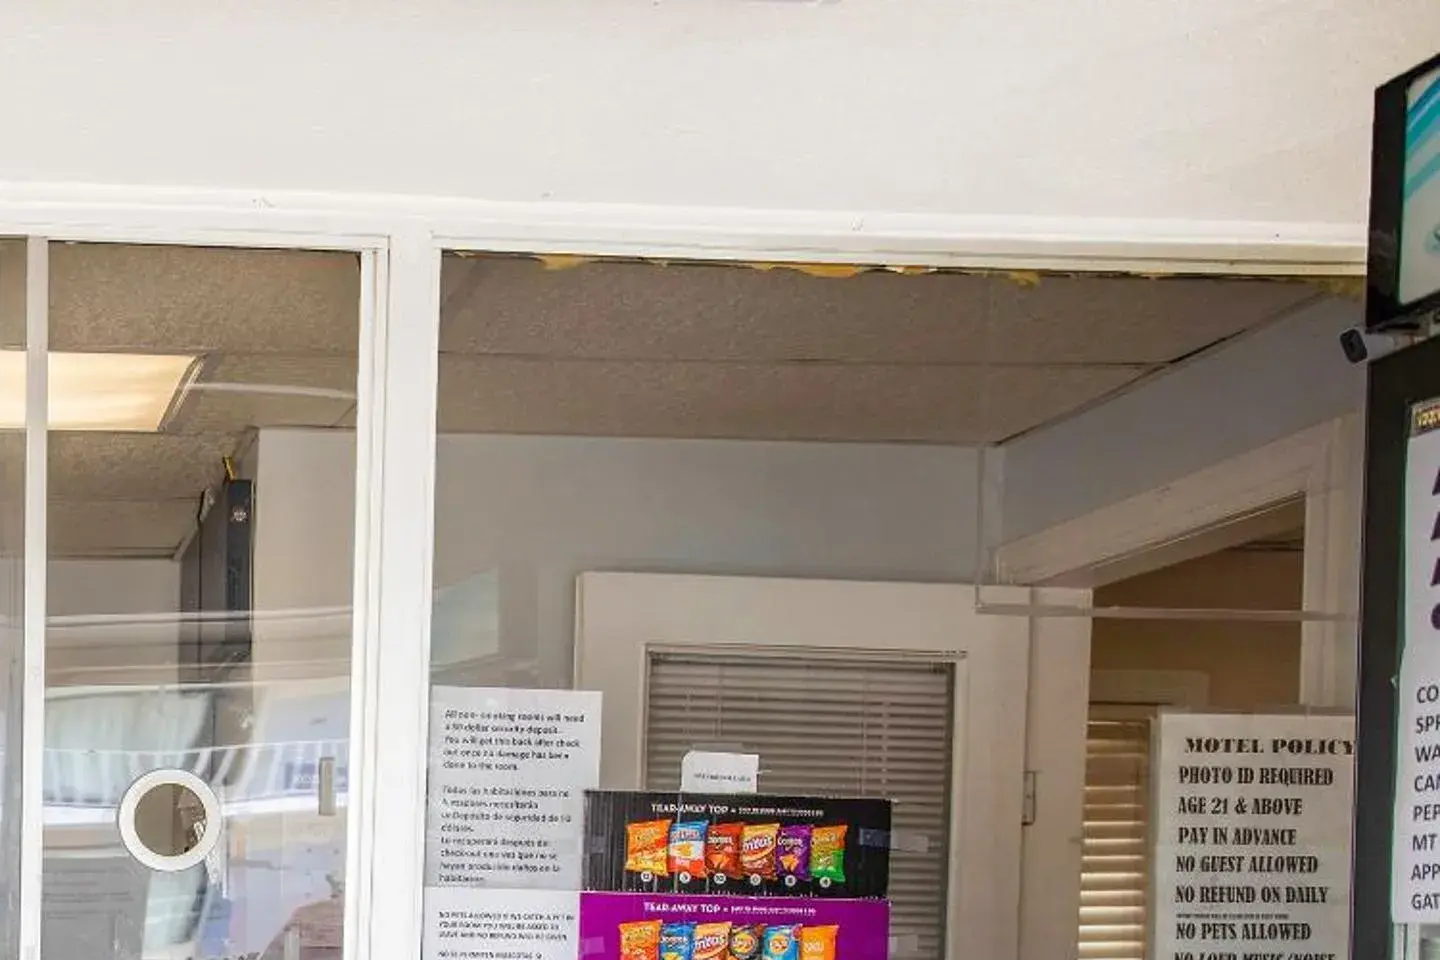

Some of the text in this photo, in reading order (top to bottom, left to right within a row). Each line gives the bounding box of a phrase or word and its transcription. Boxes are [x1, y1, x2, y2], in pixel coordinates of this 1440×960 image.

[1185, 738, 1352, 754] MOTEL POLICY
[1180, 766, 1333, 786] PHOTO ID REQUIRED
[1179, 797, 1302, 815] AGE 21 & ABOVE
[1179, 827, 1296, 845] PAY IN ADVANCE
[1412, 835, 1436, 850] MT
[1176, 856, 1318, 873] NO GUEST ALLOWED
[1176, 886, 1328, 903] NO REFUND ON DAILY
[1176, 923, 1311, 940] NO PETS ALLOWED
